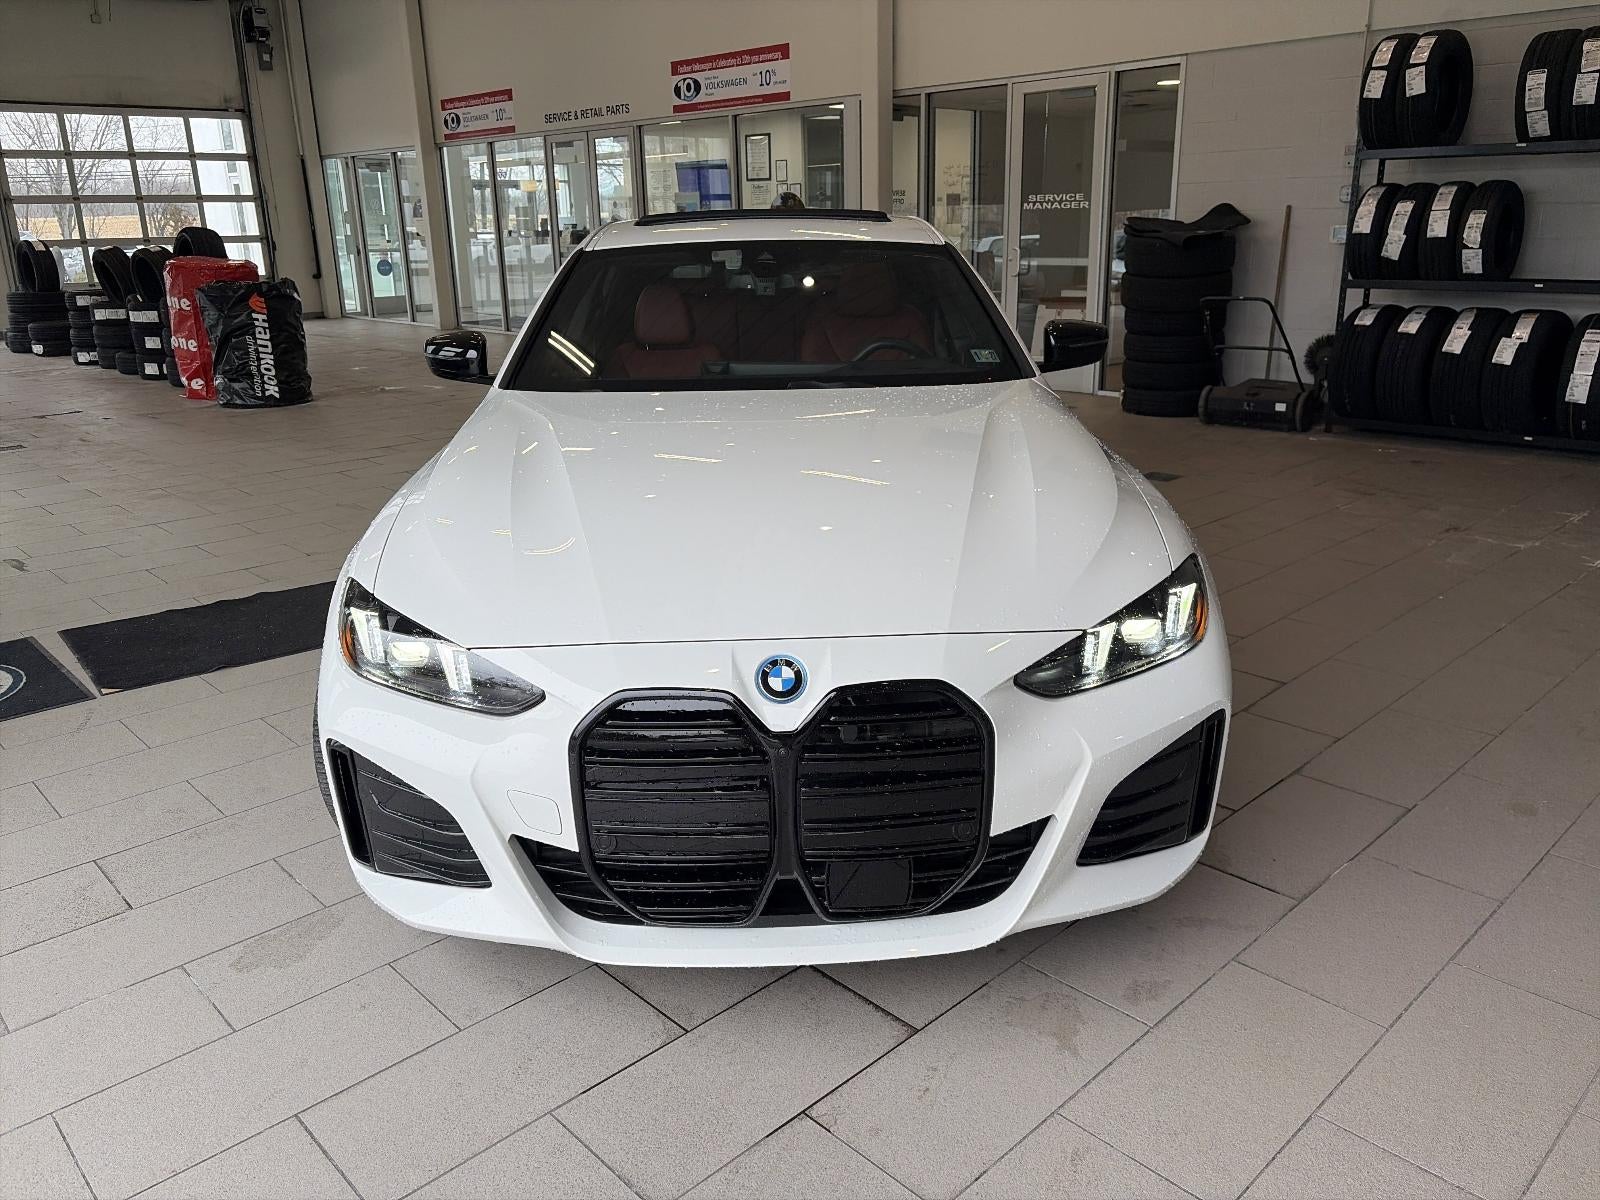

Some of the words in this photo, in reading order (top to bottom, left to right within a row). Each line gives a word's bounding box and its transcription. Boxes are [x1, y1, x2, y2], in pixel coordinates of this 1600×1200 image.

[677, 78, 695, 100] 10
[704, 77, 748, 91] VOLKSWAGEN
[544, 111, 572, 124] SERVICE
[574, 110, 579, 120] &
[580, 107, 604, 120] RETAIL
[606, 103, 630, 116] PARTS
[1028, 193, 1085, 202] SERVICE
[1023, 201, 1089, 210] MANAGER
[764, 659, 800, 672] BMW
